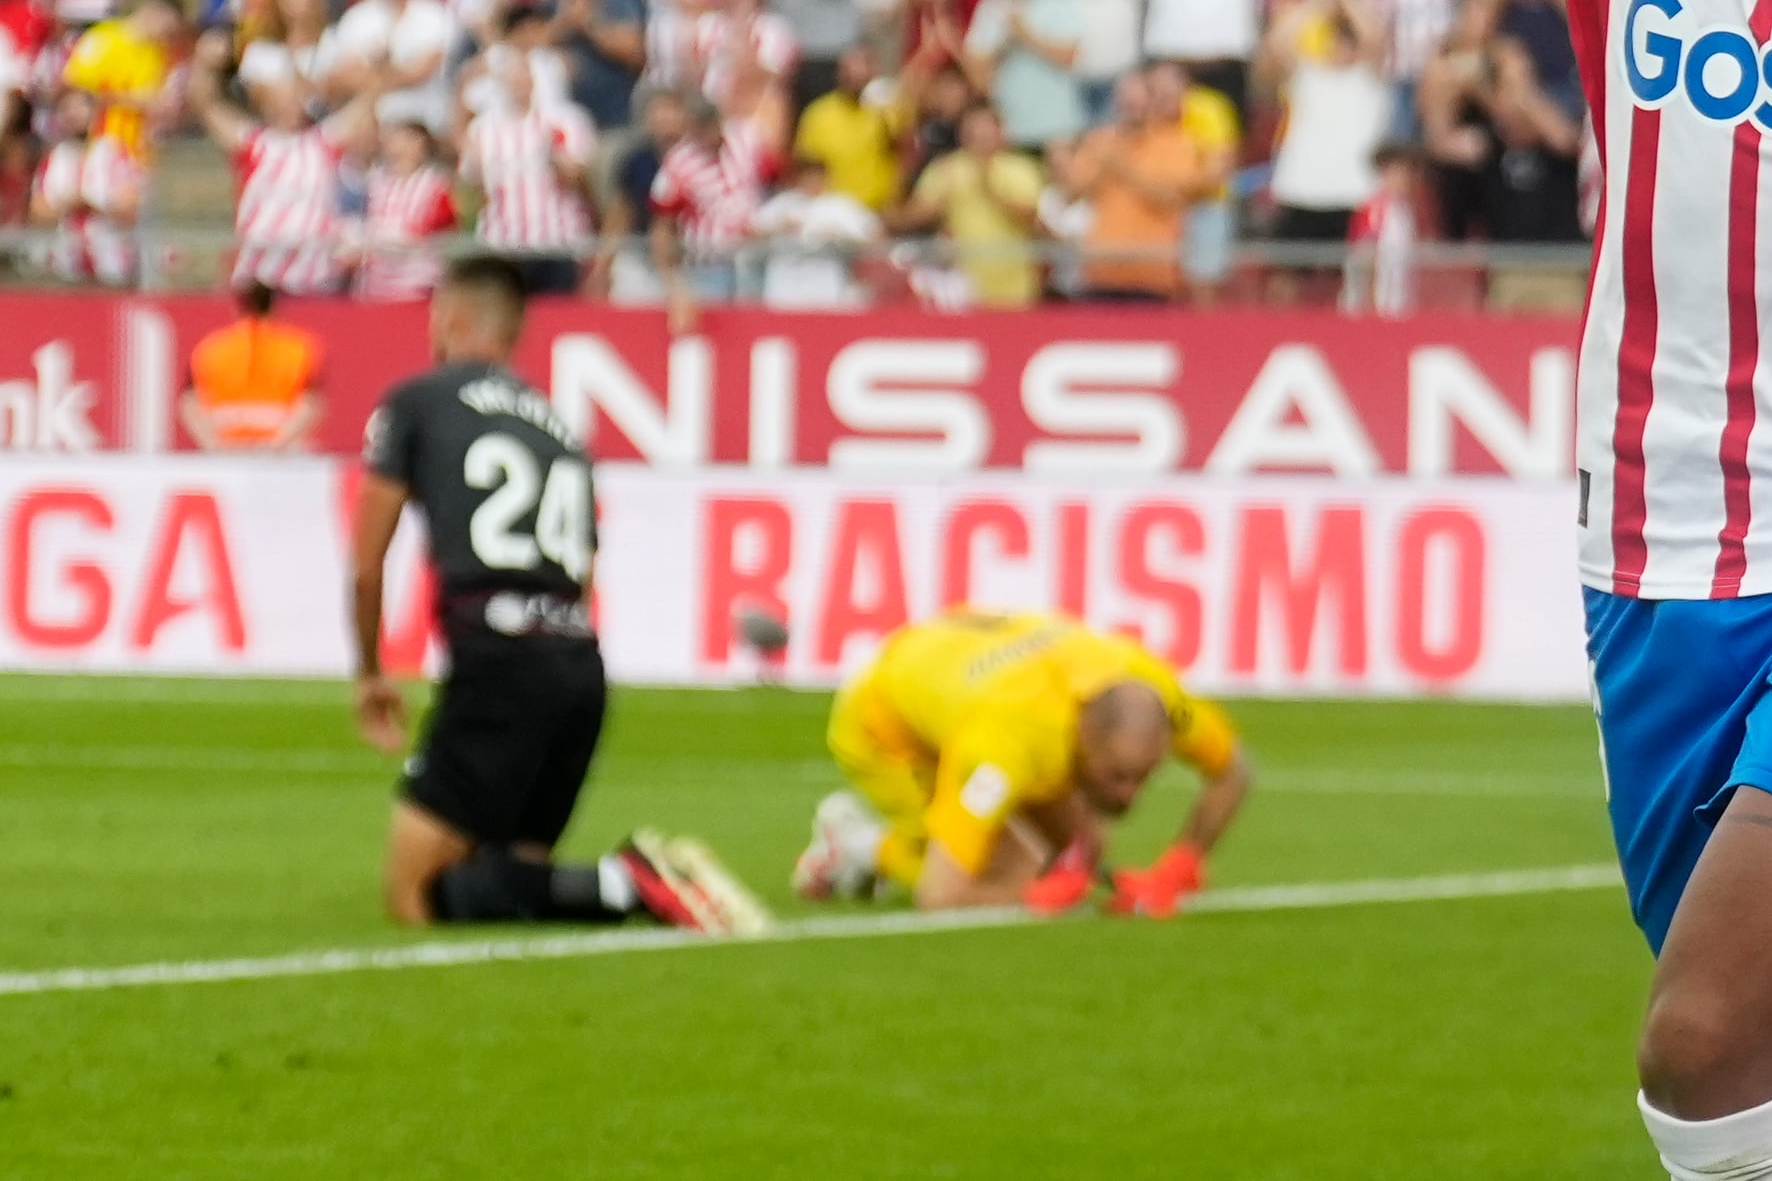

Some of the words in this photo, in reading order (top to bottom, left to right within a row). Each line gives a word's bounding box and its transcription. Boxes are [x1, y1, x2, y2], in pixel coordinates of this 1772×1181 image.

[551, 332, 1572, 476] NISSAN
[464, 431, 594, 583] 24
[696, 491, 1490, 683] RACISMO
